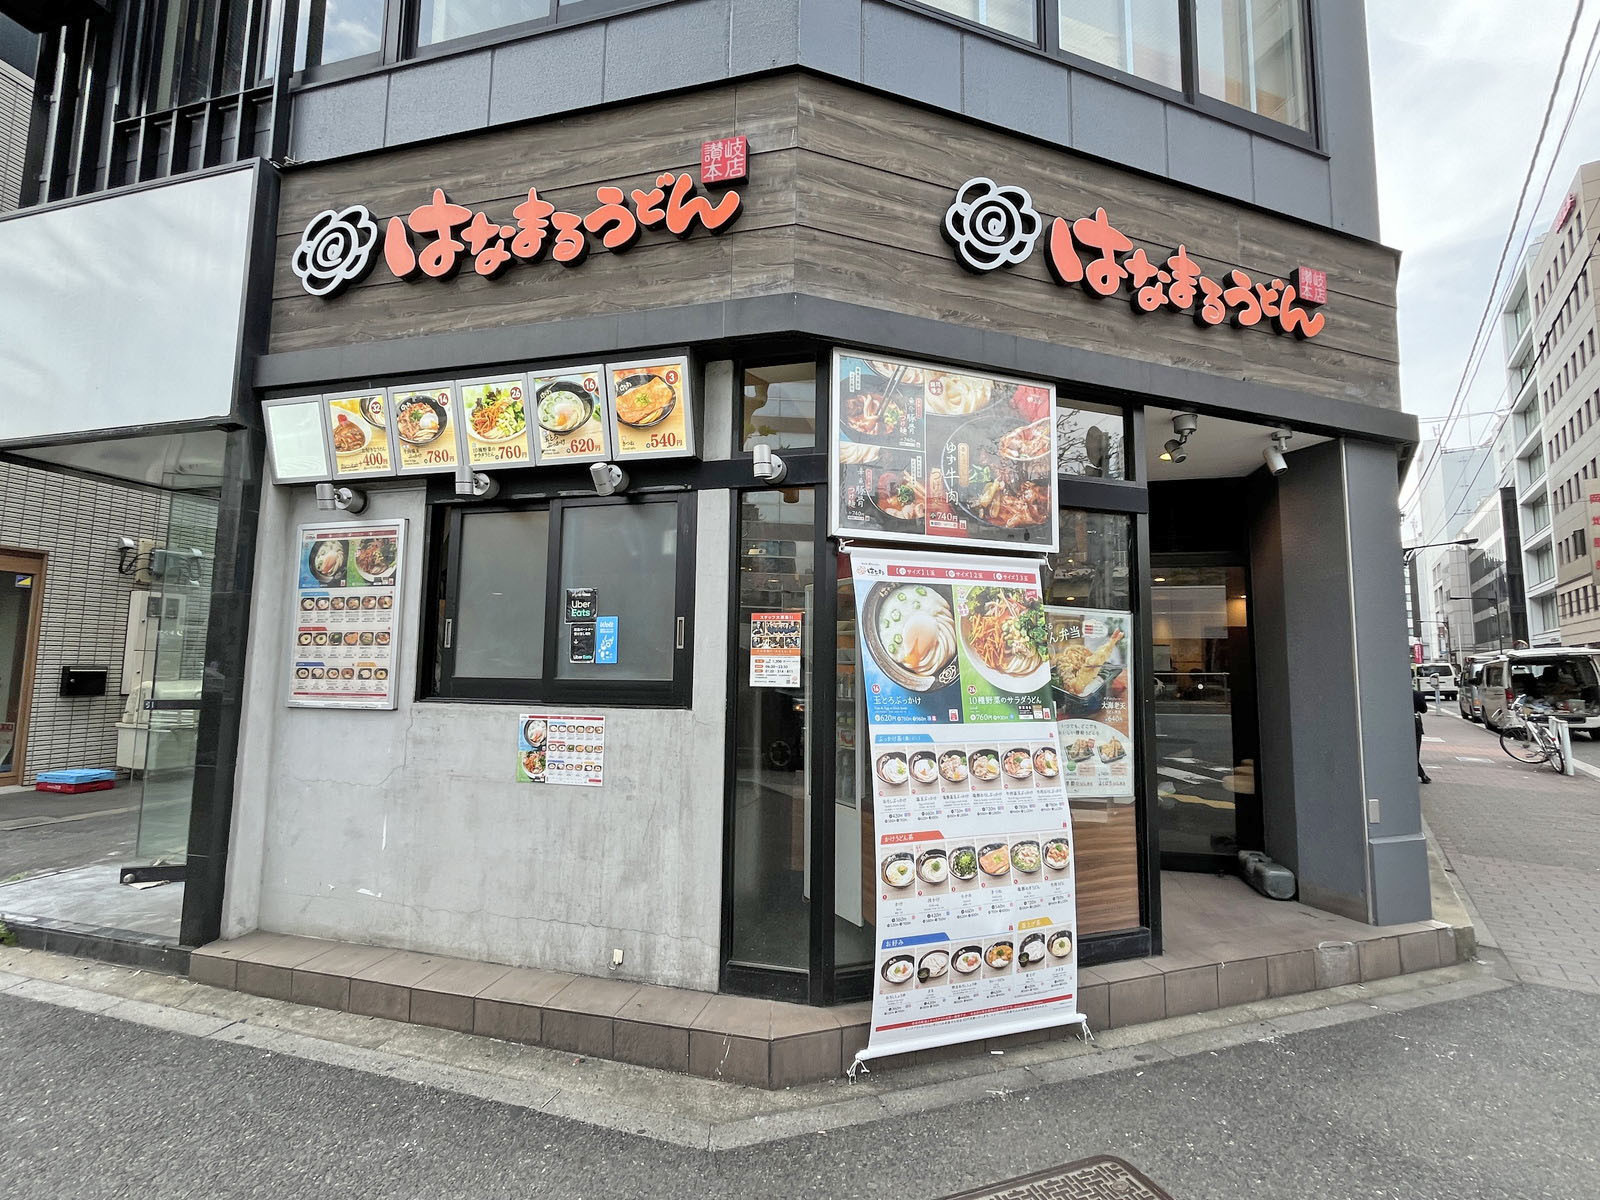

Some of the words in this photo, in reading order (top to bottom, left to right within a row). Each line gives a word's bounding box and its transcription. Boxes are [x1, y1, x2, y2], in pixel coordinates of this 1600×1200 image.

[704, 137, 744, 163] 讃岐
[703, 157, 744, 181] 本店
[384, 171, 740, 277] はなまるうどん
[1050, 207, 1325, 338] はなまるうどん
[669, 373, 676, 382] 3
[585, 380, 595, 390] 16
[439, 394, 448, 406] 14
[511, 389, 521, 399] 26
[372, 402, 382, 413] 32
[571, 438, 601, 454] 620円
[650, 432, 683, 449] 540円
[427, 449, 455, 463] 780円
[498, 445, 528, 459] 760円
[944, 441, 960, 506] ゆず牛肉
[873, 695, 921, 705] 玉とろぶっかけ
[969, 695, 1042, 705] 10種野菜のサラダうどん
